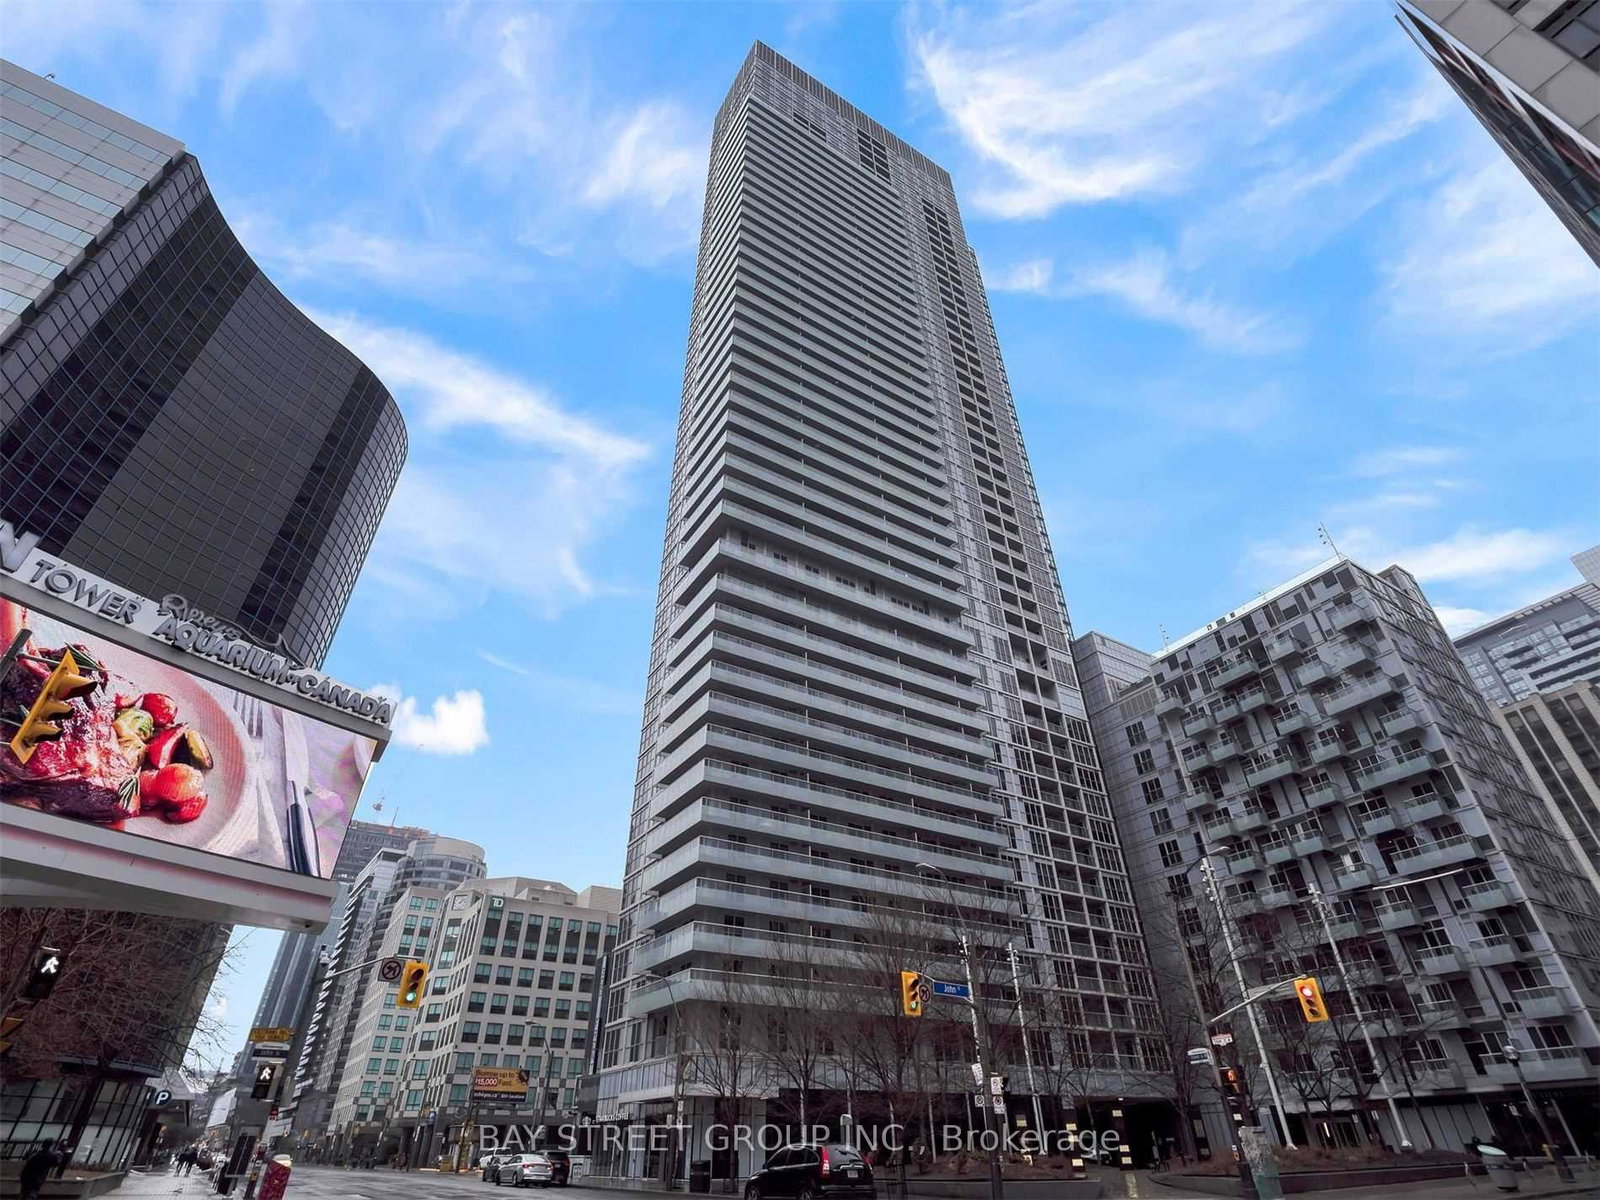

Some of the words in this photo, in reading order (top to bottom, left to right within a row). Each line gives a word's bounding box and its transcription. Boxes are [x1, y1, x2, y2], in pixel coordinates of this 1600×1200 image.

[30, 559, 141, 624] TOWER
[153, 617, 290, 684] AQUARIUM
[297, 675, 391, 723] CANADA
[492, 897, 504, 908] TD
[943, 984, 957, 994] John
[155, 1091, 169, 1105] P
